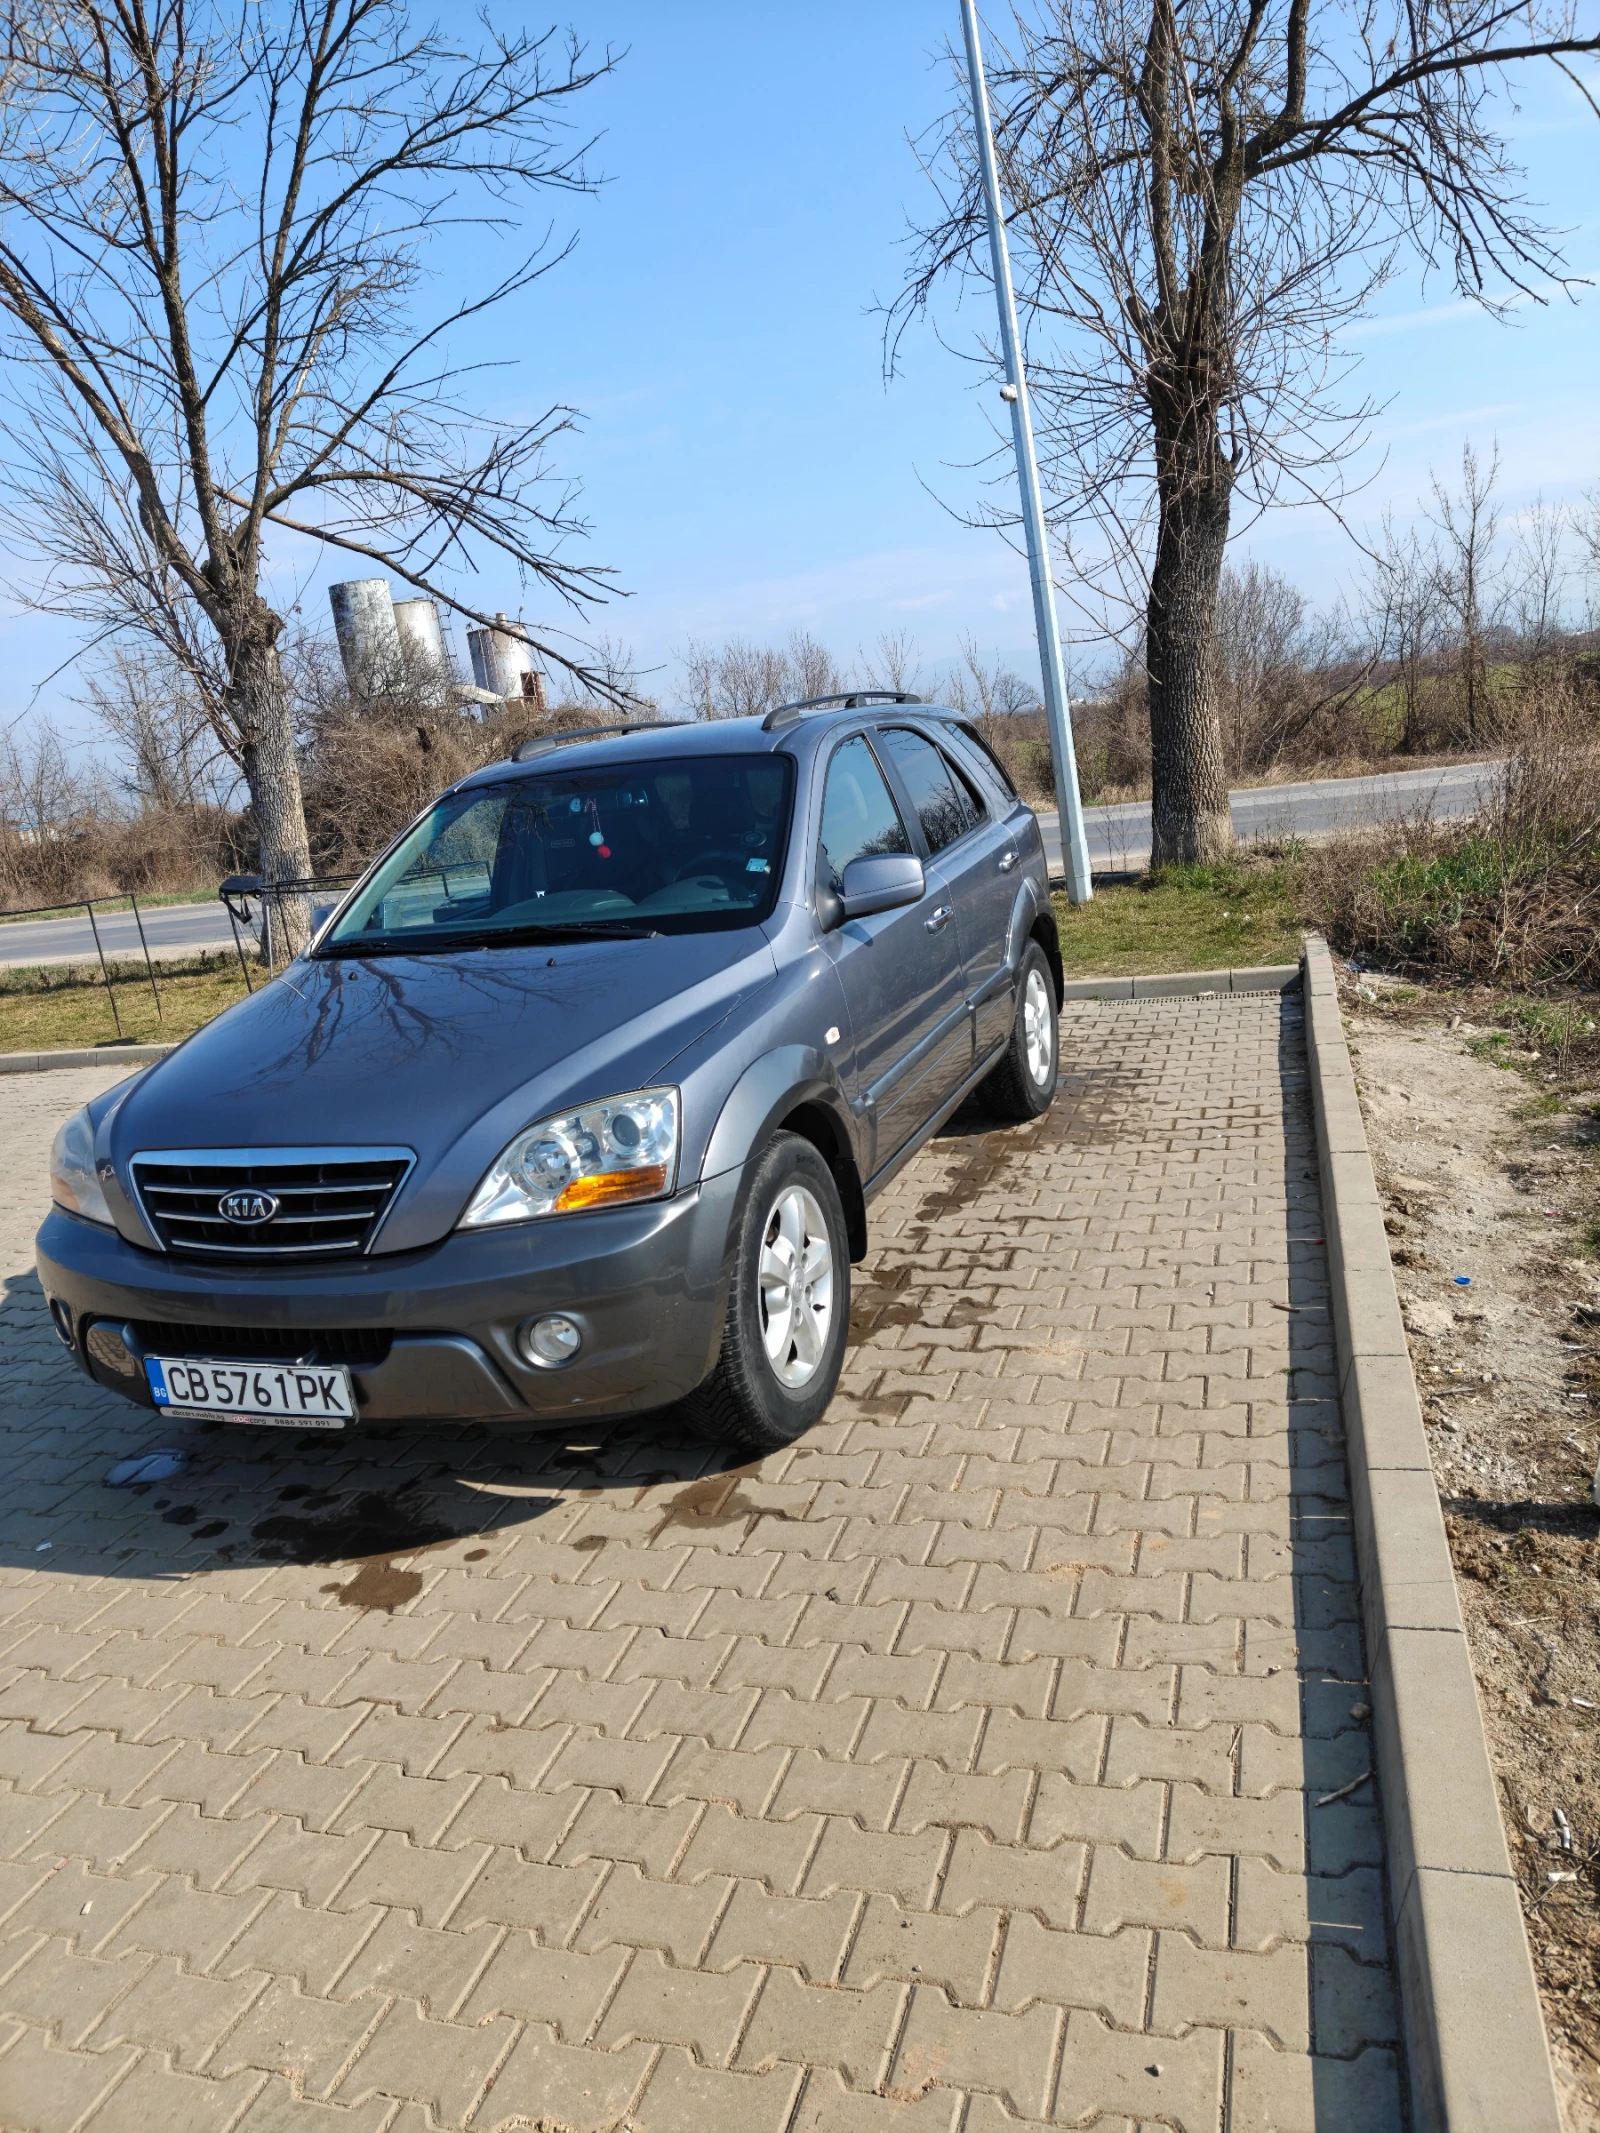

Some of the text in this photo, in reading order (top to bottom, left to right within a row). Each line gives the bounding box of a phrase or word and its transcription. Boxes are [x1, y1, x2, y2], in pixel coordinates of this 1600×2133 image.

[227, 1198, 266, 1216] KIA
[154, 1387, 167, 1398] BG
[274, 1418, 295, 1426] 0886
